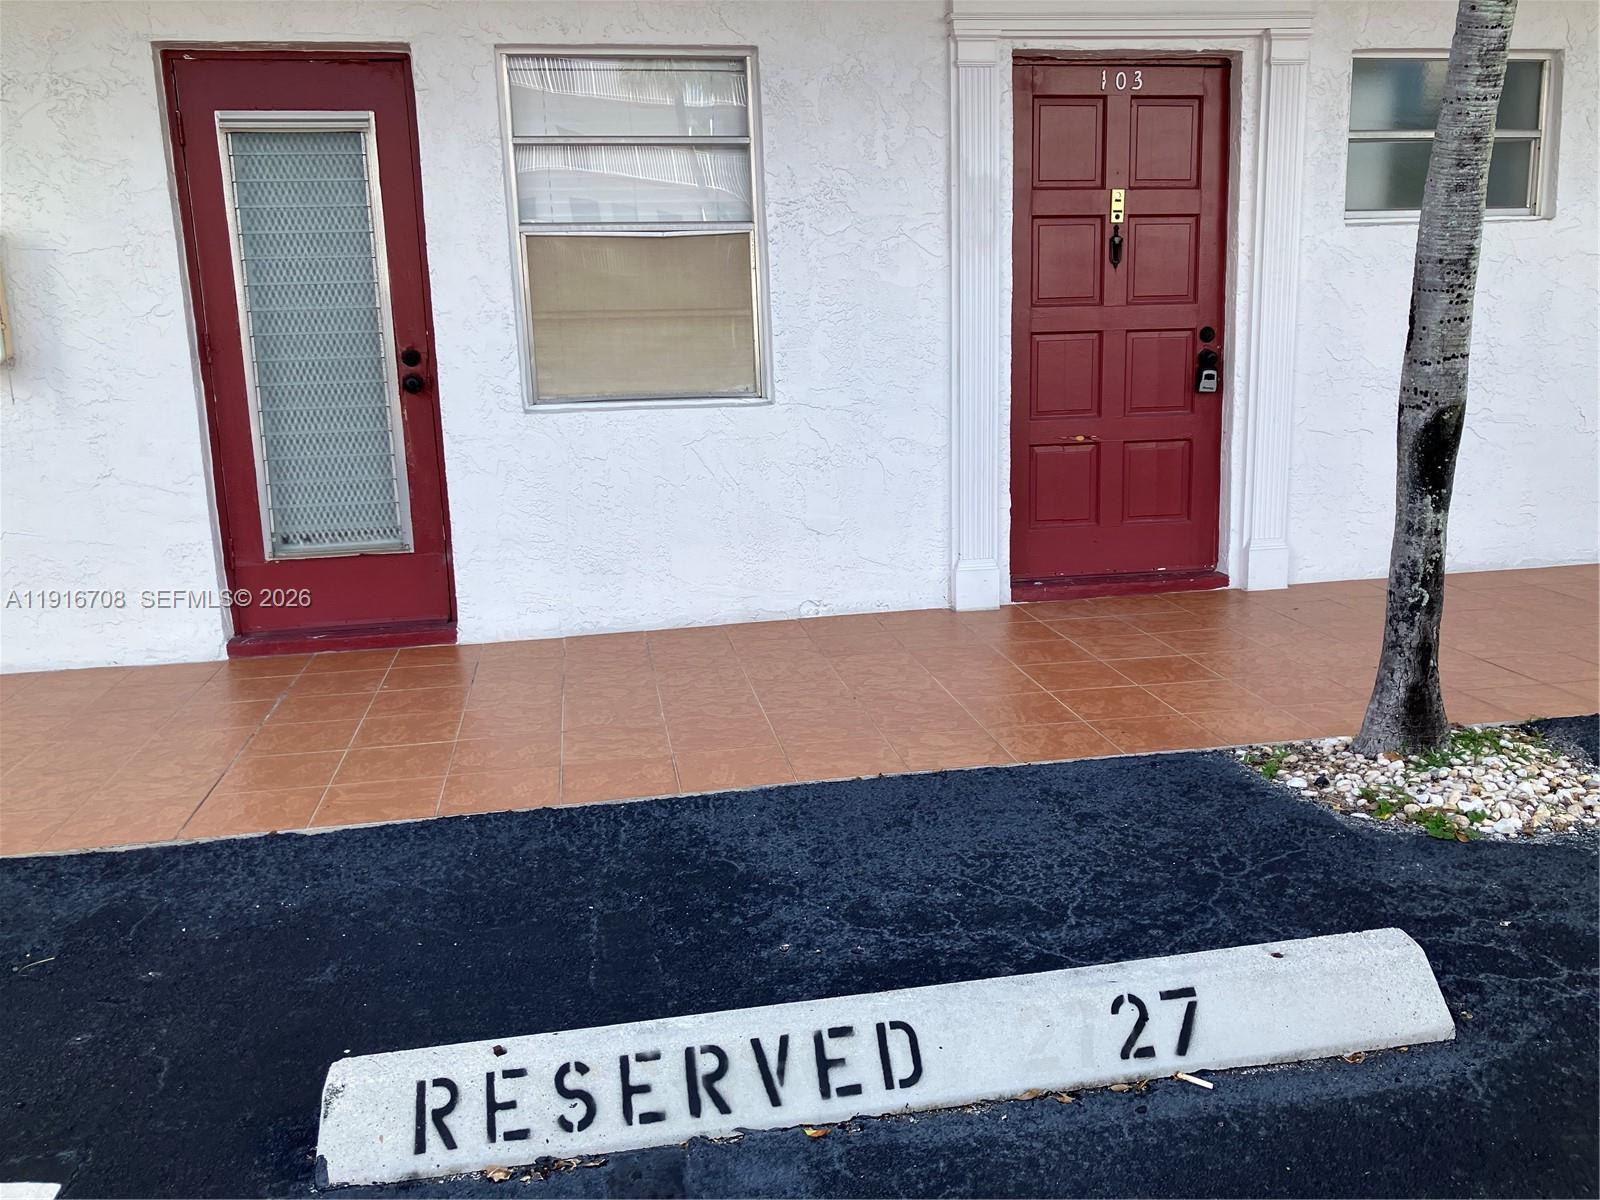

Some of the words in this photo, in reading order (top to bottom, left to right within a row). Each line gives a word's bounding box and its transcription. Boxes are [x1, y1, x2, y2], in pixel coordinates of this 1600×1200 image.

[1101, 69, 1143, 91] 103
[414, 1020, 924, 1155] RESERVED
[1110, 986, 1198, 1060] 27
